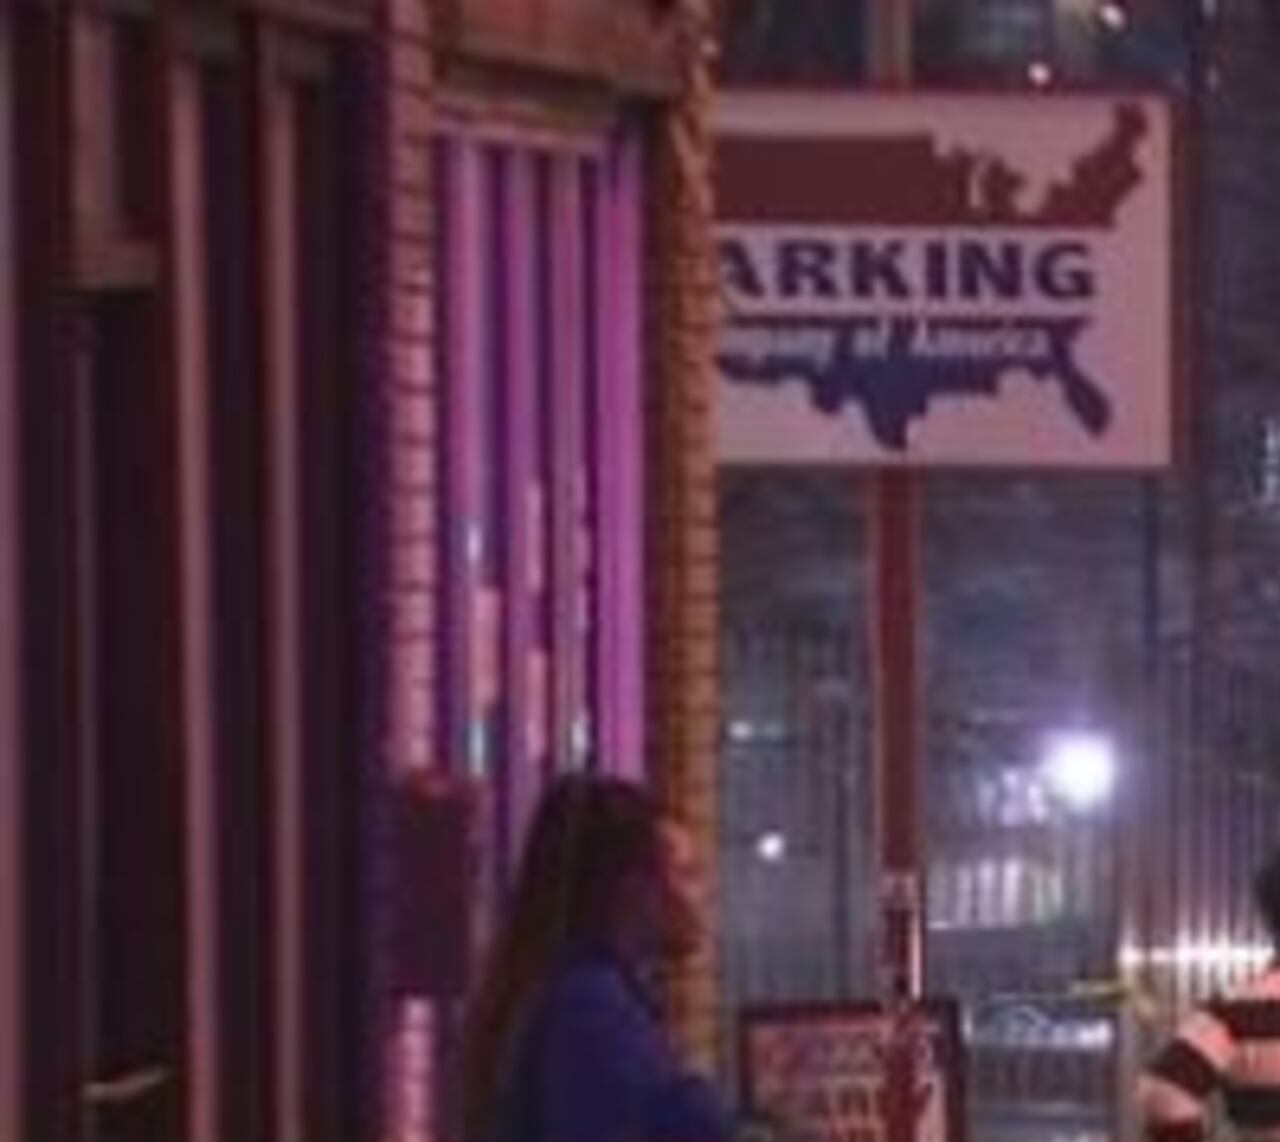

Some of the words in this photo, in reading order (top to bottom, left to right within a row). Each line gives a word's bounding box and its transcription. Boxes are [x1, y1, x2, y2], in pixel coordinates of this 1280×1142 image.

[717, 239, 1095, 300] ARKING
[853, 318, 890, 361] of
[906, 319, 1050, 359] America
